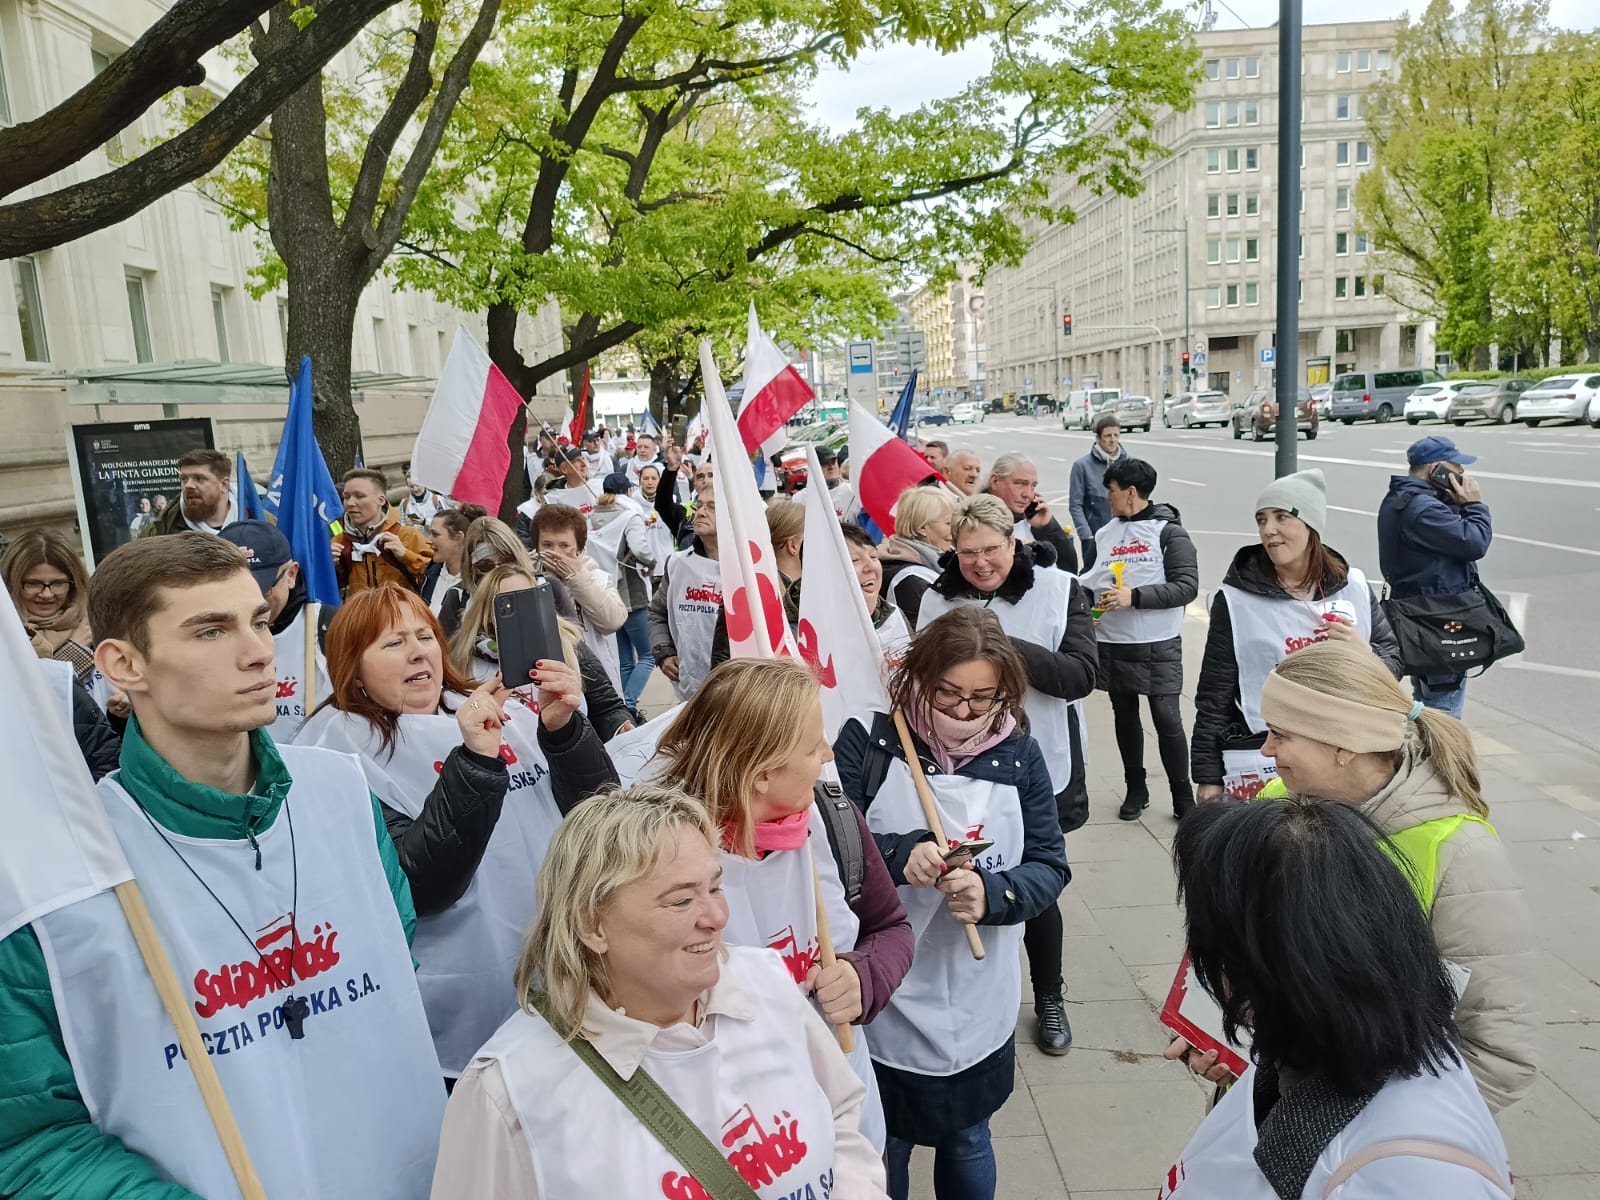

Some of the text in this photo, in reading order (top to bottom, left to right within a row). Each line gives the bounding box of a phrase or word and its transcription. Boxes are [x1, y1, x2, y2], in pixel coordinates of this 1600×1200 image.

[101, 461, 138, 470] WOLFGANG
[139, 459, 170, 467] AMADEUS
[98, 466, 181, 480] LA FINTA GIARDIN
[696, 605, 717, 614] POLSK
[194, 915, 341, 1018] SOLIDARNOŚĆ
[164, 972, 381, 1070] PCZTA POKA S.A.
